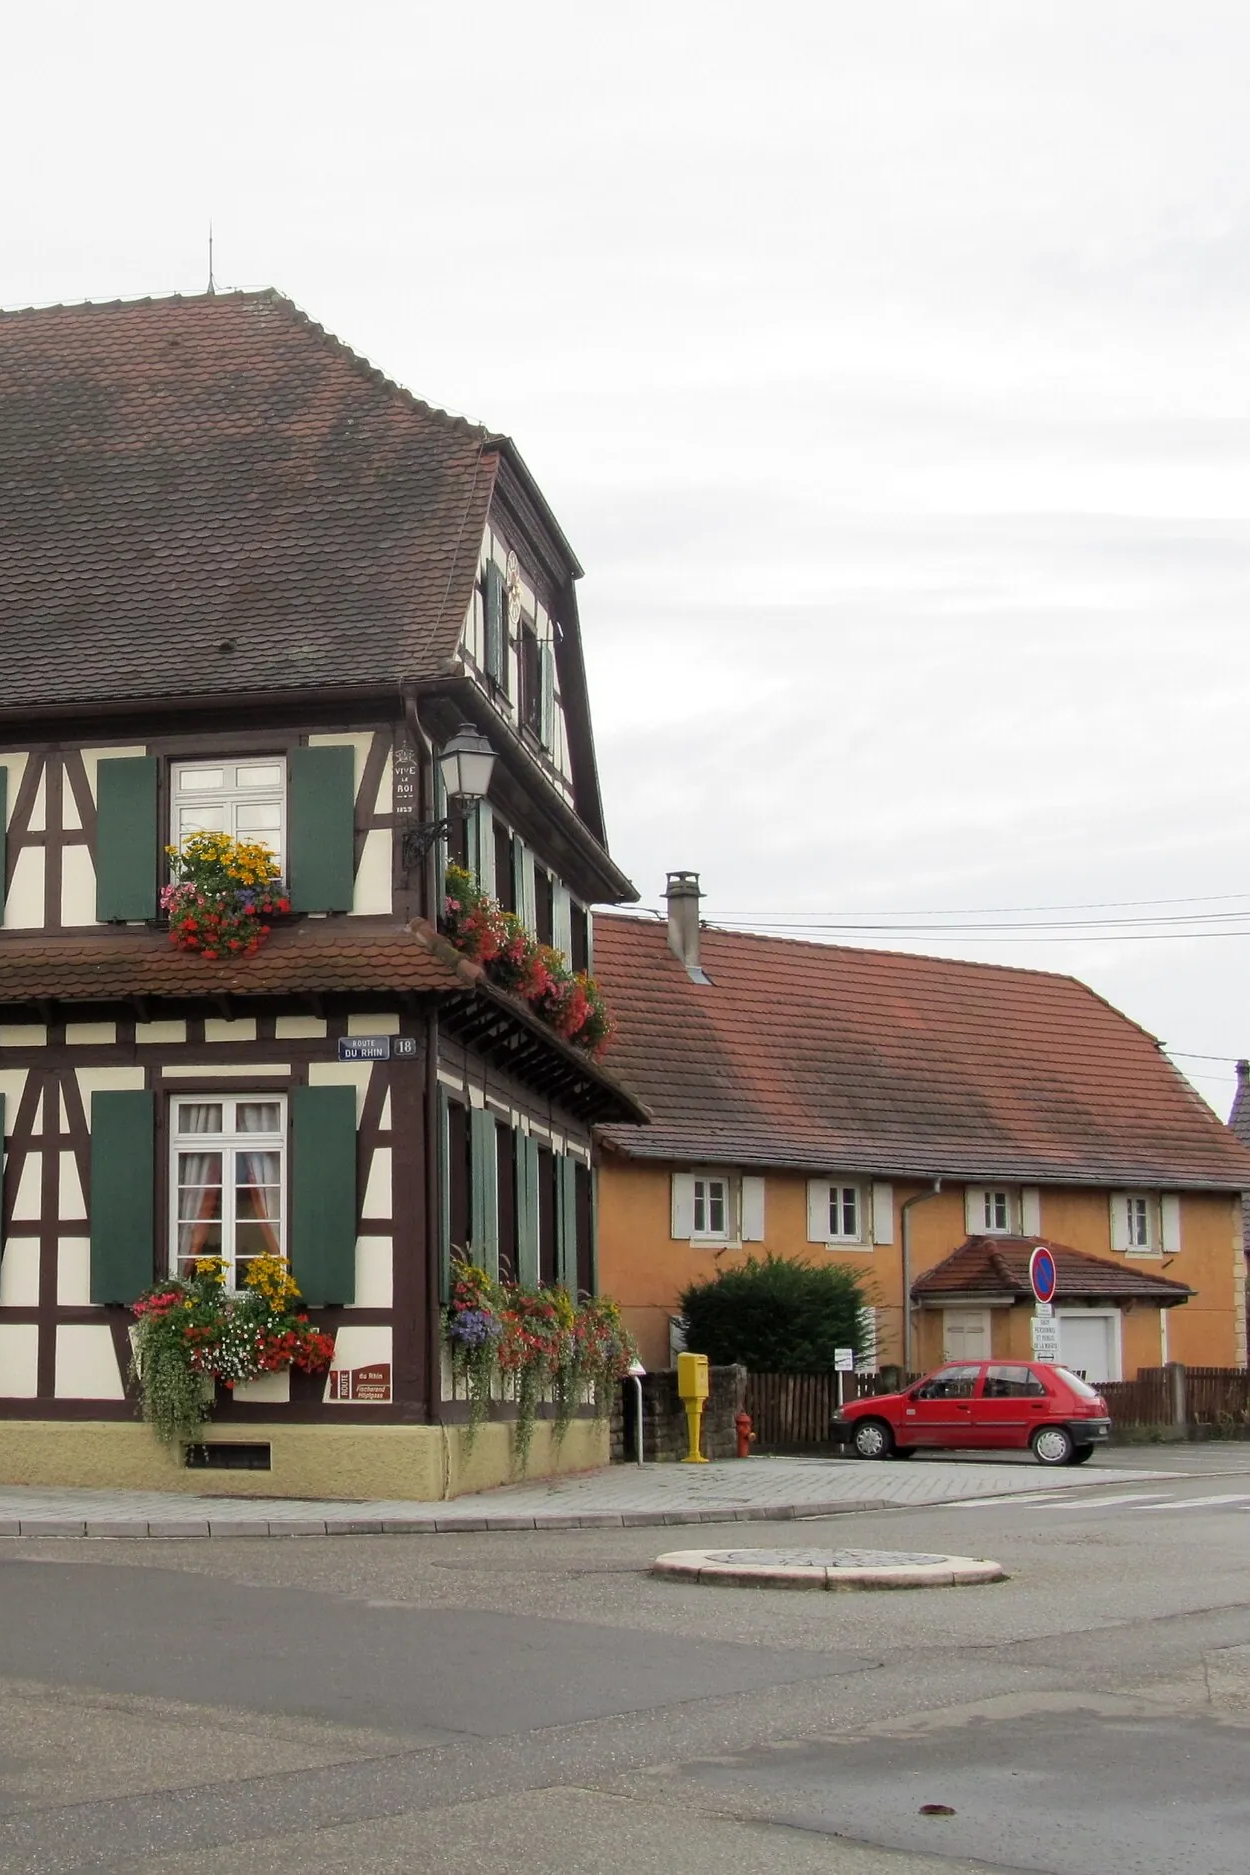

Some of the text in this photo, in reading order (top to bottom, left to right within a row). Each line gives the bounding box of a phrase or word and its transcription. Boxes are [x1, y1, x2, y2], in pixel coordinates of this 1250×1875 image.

[395, 766, 416, 775] VIVE
[397, 784, 413, 793] ROI
[399, 1041, 411, 1053] 18
[345, 1048, 383, 1058] DU RHIN
[341, 1374, 349, 1396] ROUTE
